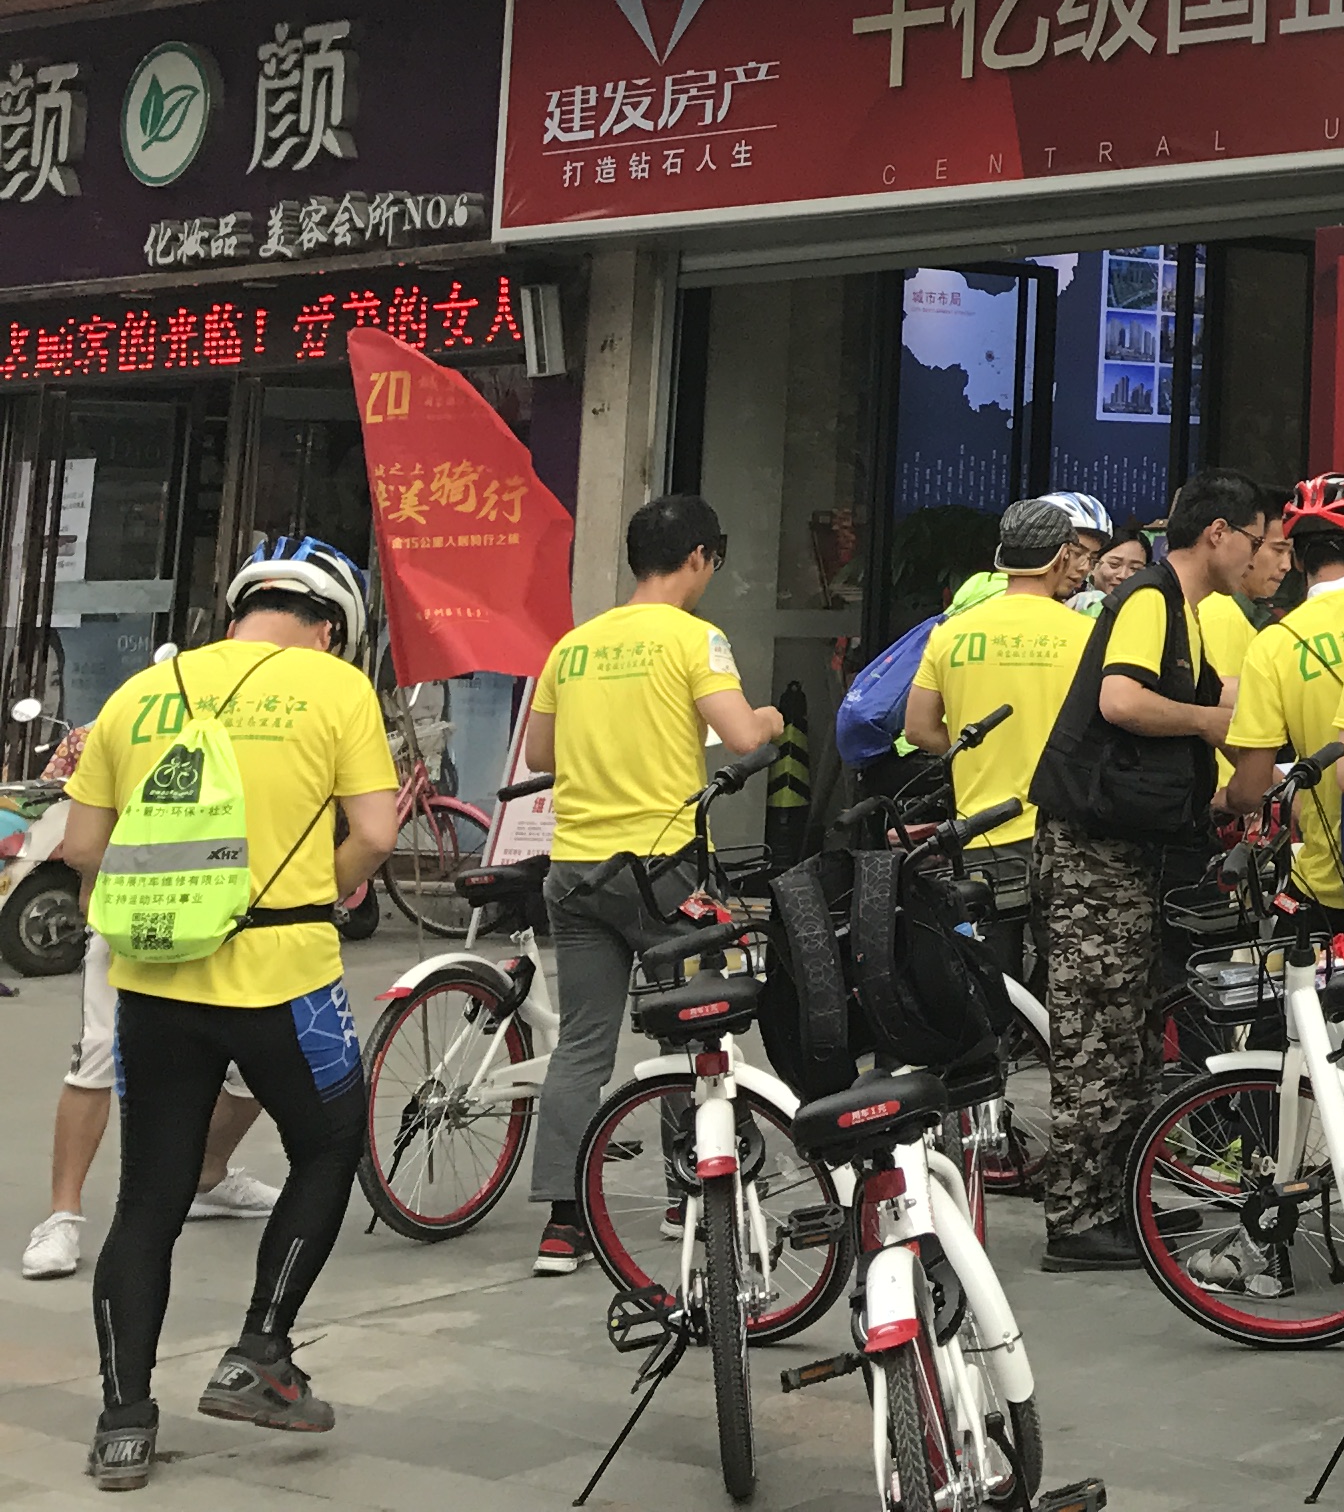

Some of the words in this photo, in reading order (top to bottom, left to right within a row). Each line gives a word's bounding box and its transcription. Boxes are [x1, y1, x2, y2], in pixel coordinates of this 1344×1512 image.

[247, 19, 350, 175] 颜
[542, 60, 780, 144] 建发房产
[562, 141, 754, 188] 打造钻石人生
[881, 129, 1227, 186] CENTRAL
[143, 211, 238, 267] 化妆品
[366, 370, 411, 424] 20
[103, 1440, 146, 1463] NIKE
